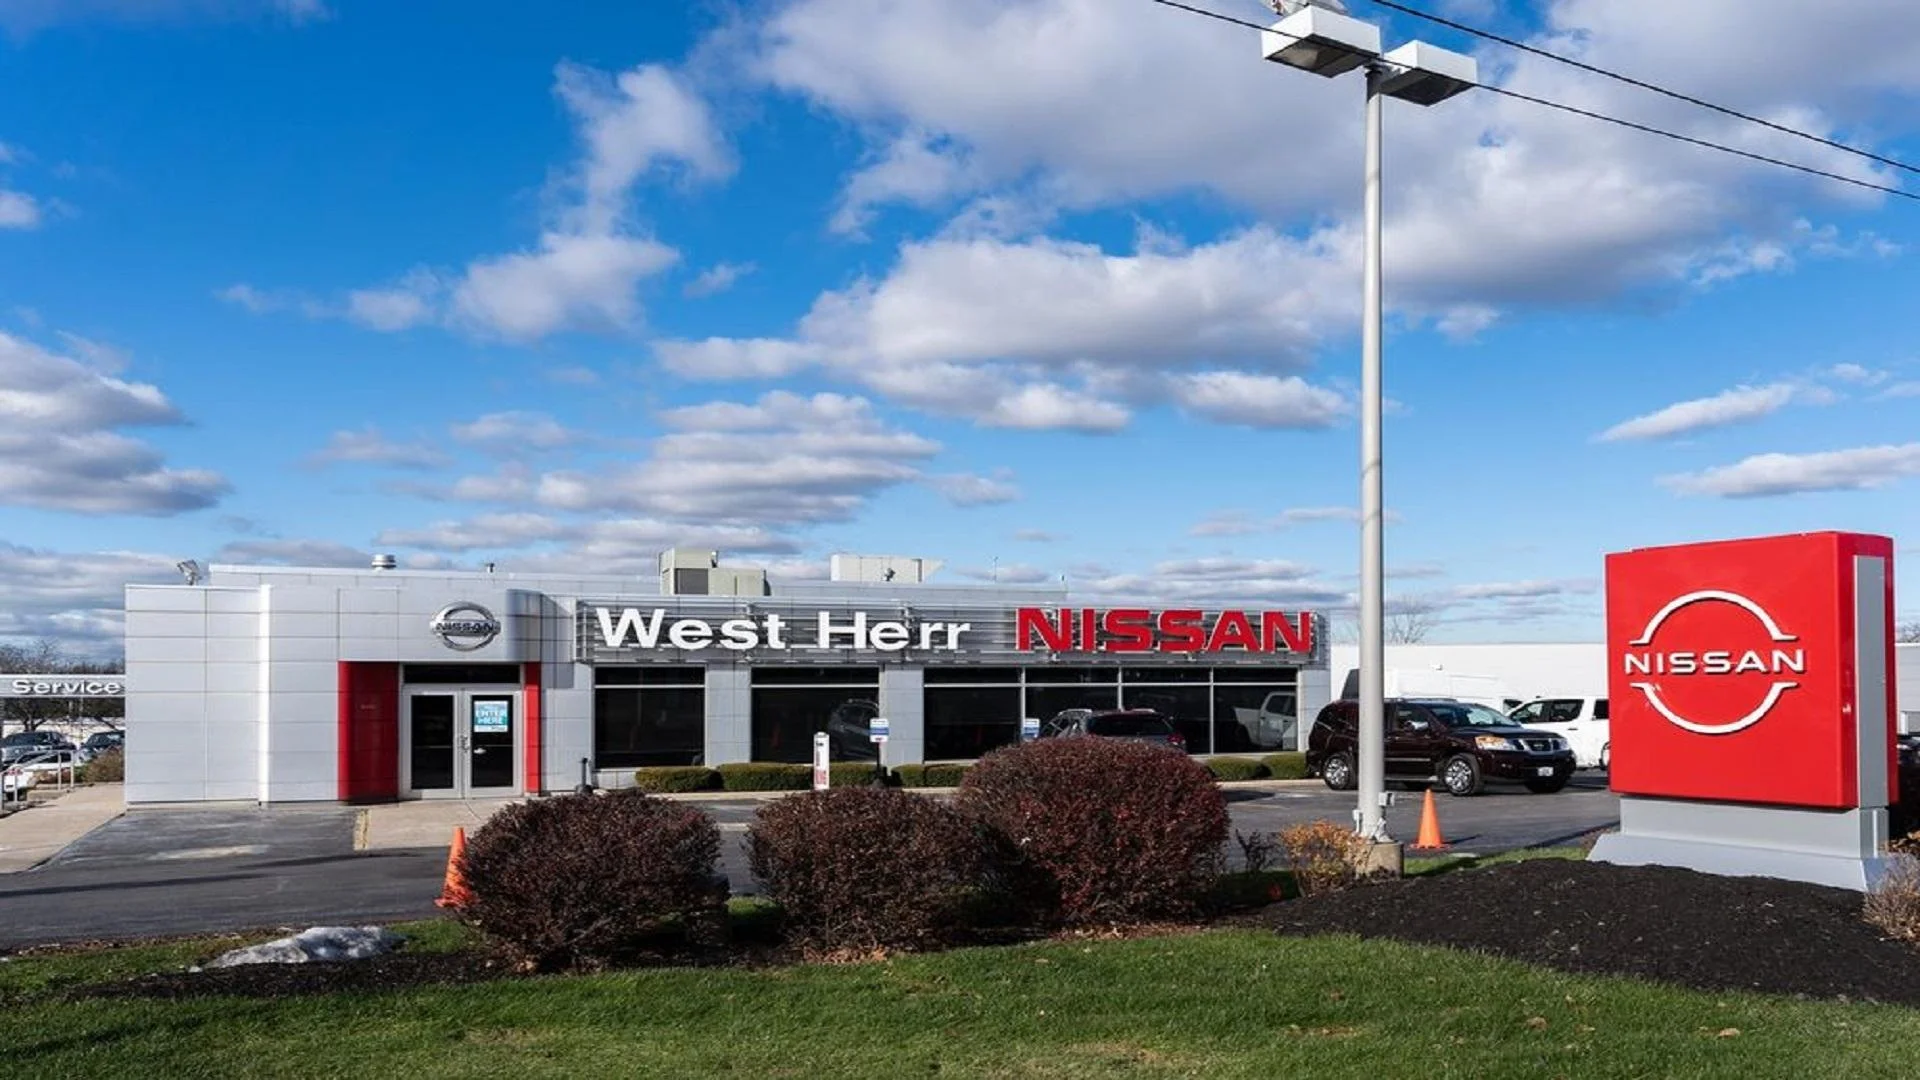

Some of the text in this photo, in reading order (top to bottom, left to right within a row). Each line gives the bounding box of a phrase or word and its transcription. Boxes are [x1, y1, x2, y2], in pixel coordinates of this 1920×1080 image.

[435, 622, 495, 632] NISSAN
[596, 607, 1312, 652] West Herr NISSAN
[1624, 649, 1806, 674] NISSAN
[12, 679, 121, 694] Service
